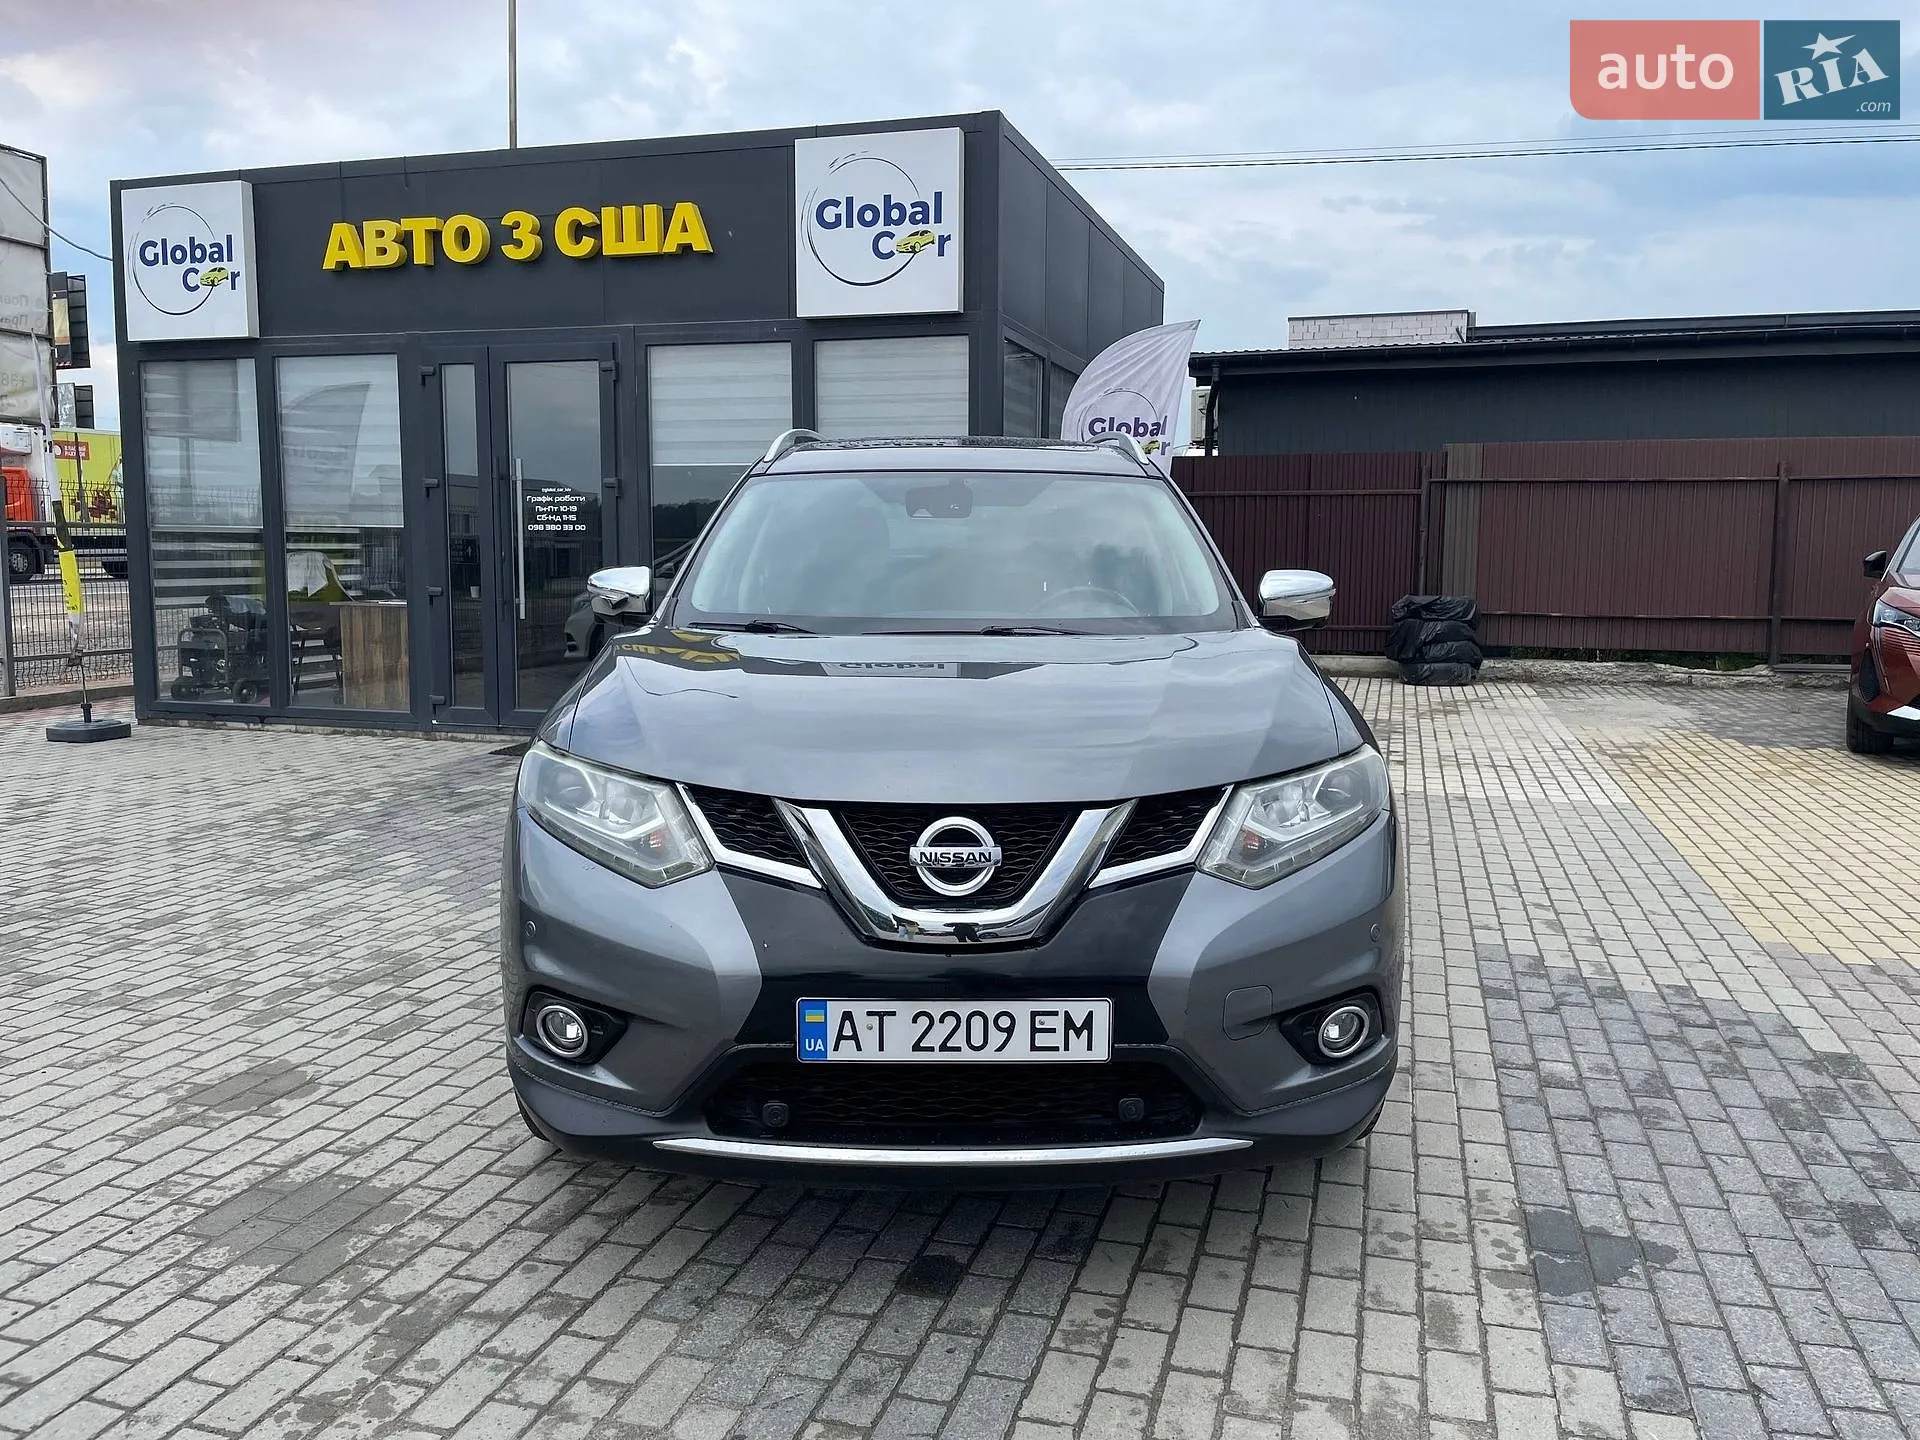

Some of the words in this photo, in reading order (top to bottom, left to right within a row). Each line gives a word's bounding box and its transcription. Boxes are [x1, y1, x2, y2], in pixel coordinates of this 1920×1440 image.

[815, 191, 943, 230] Global
[139, 234, 233, 267] Global
[322, 214, 491, 272] АВТО
[554, 202, 713, 260] США
[872, 229, 952, 260] Cr
[182, 267, 240, 292] Cr
[1088, 415, 1168, 438] Global
[555, 495, 585, 503] роботи
[919, 851, 993, 863] NISSAN
[804, 1038, 825, 1052] UA
[832, 1010, 897, 1053] AT
[911, 1010, 1017, 1053] 2209
[1029, 1010, 1094, 1053] EM
